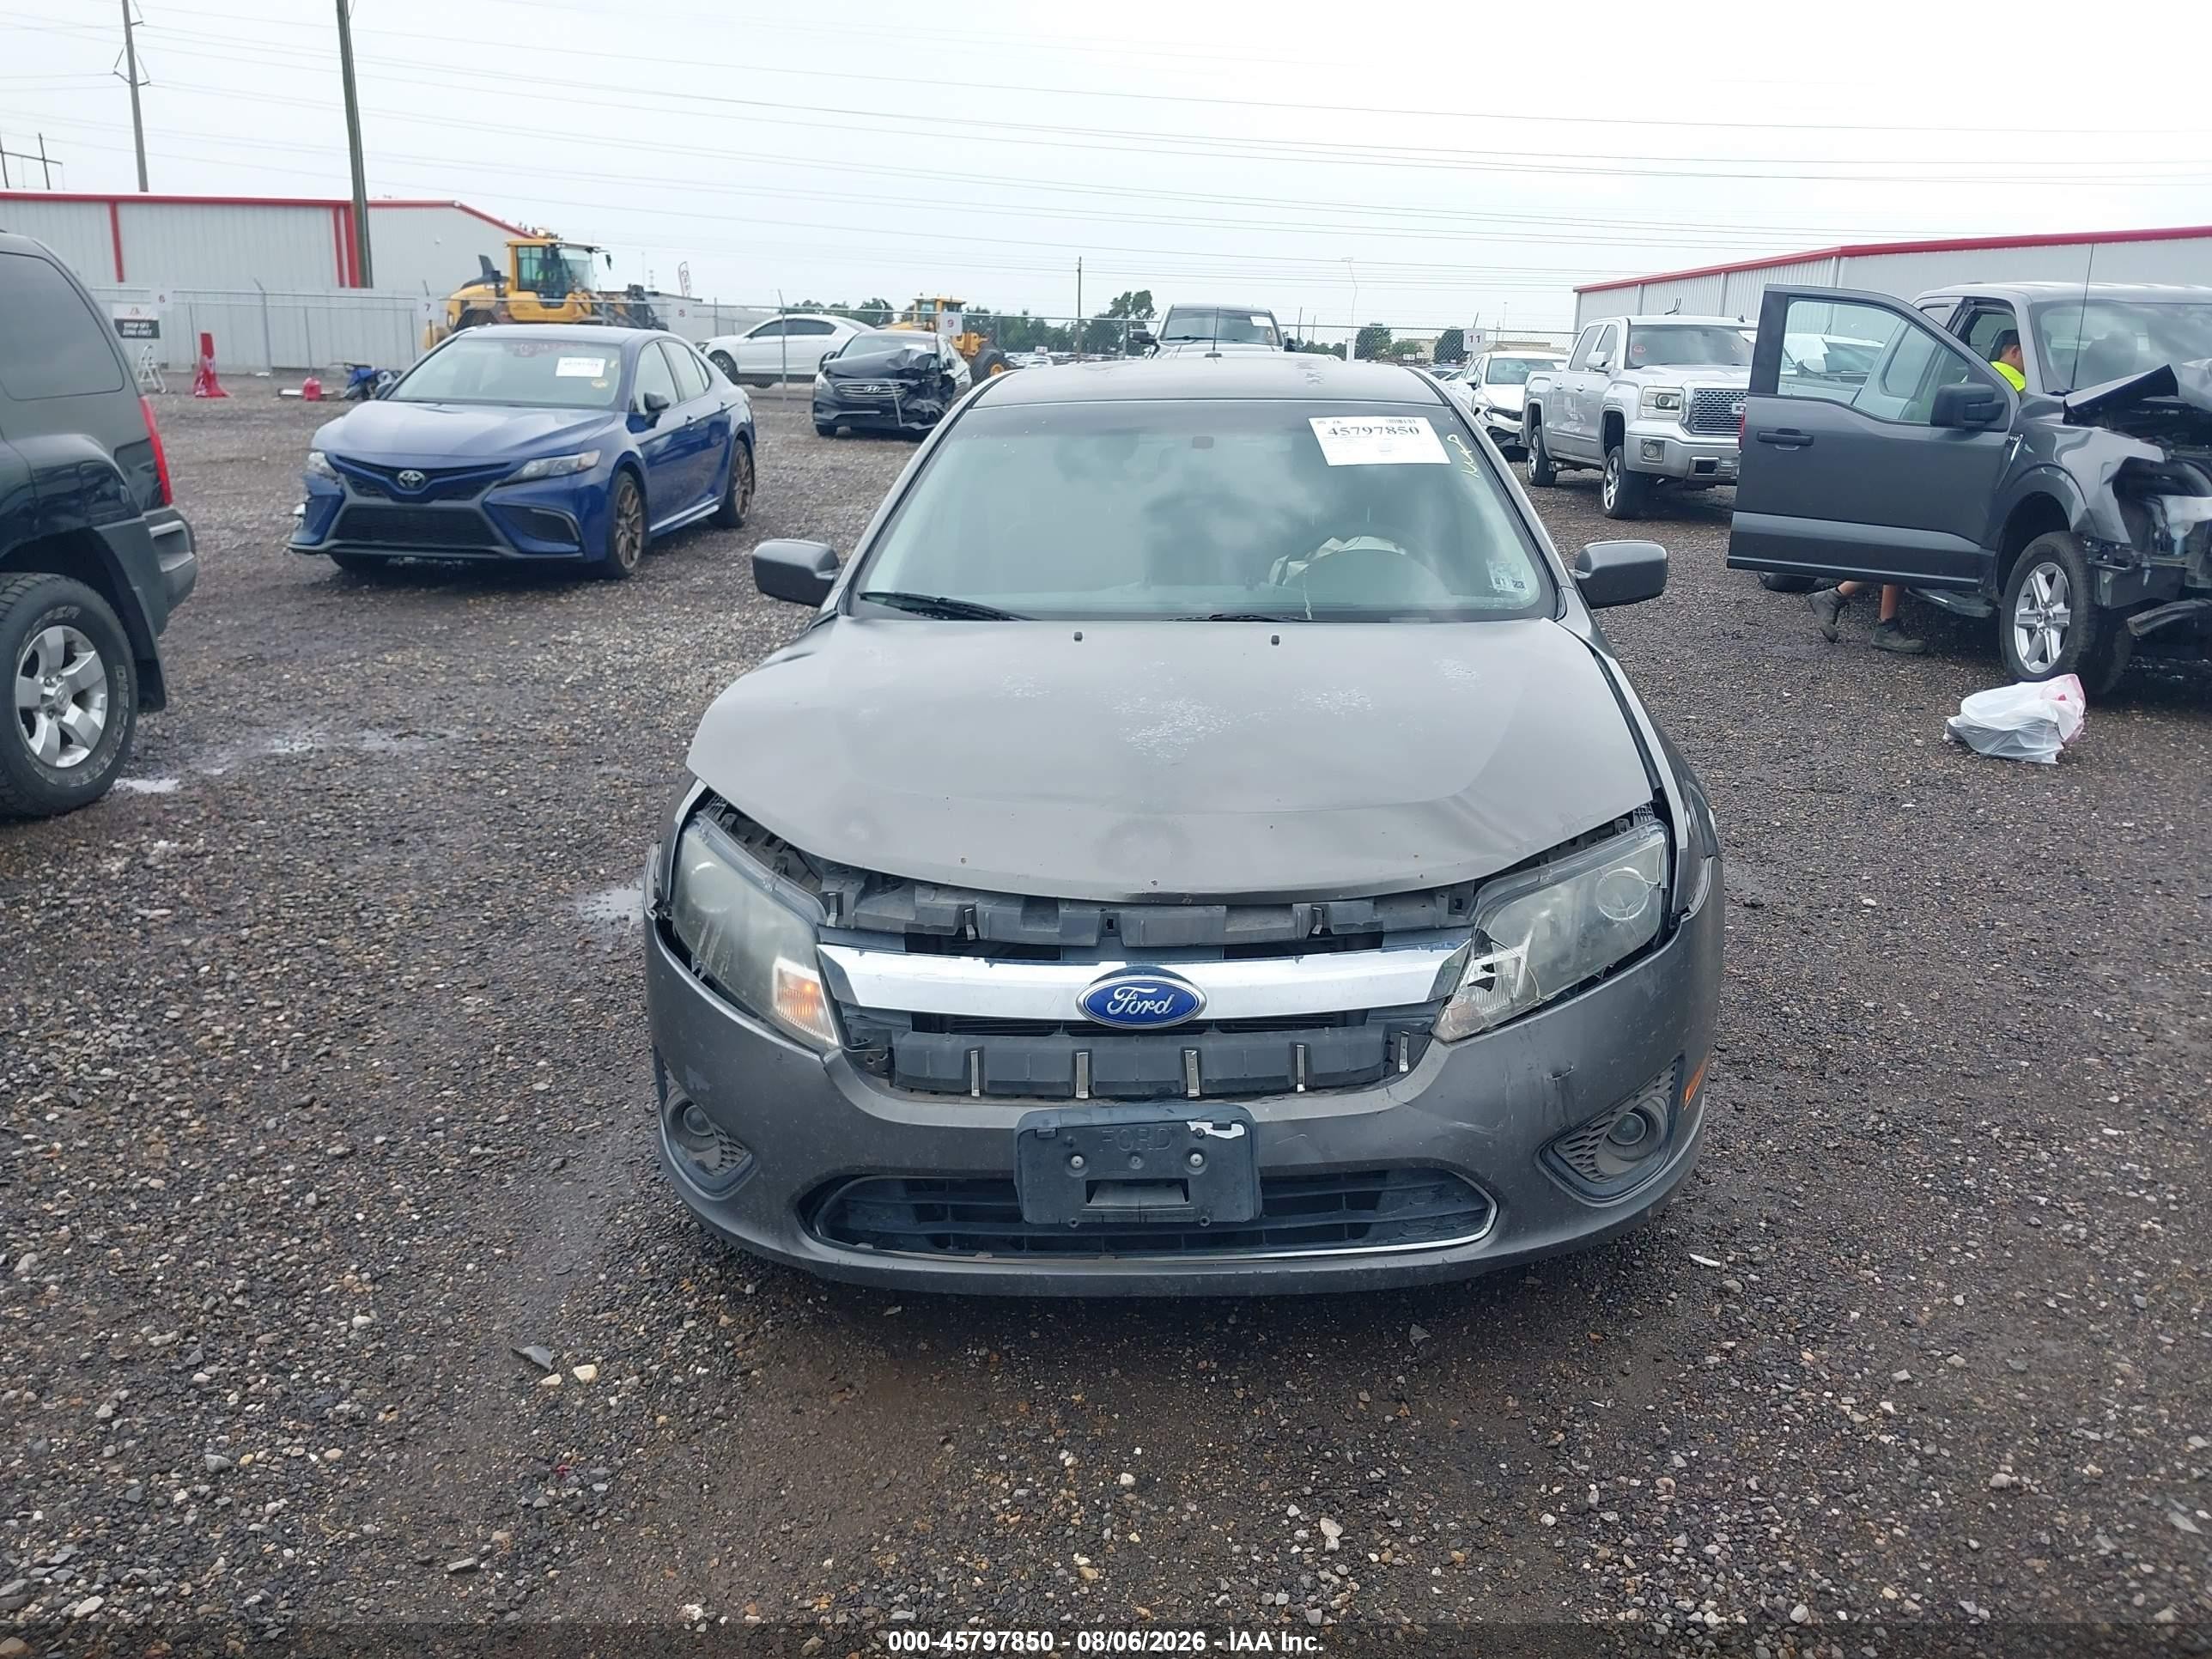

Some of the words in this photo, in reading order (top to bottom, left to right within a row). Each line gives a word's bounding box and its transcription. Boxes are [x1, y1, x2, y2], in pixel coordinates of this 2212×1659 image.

[424, 302, 431, 312] 7
[1469, 335, 1481, 343] 11
[1327, 426, 1420, 436] 45797850
[1106, 986, 1176, 1015] Ford
[1098, 1126, 1174, 1152] FORD
